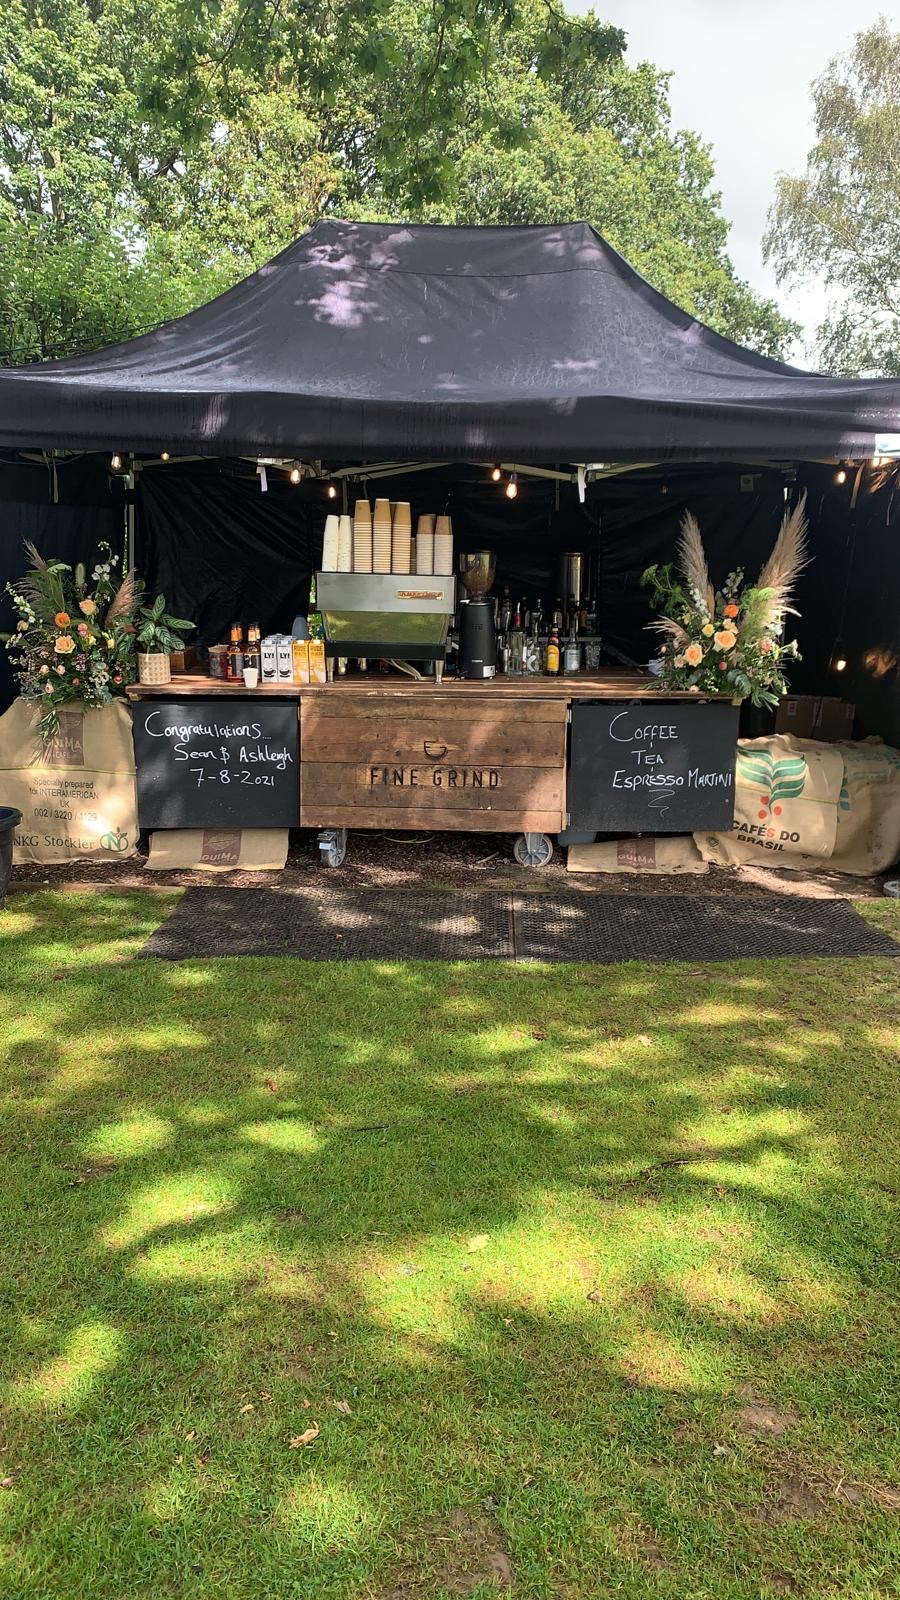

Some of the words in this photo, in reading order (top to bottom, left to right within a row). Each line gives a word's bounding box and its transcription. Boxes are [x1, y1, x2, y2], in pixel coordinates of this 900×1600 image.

[173, 743, 217, 761] Sean
[239, 745, 293, 770] Ashleigh
[33, 776, 63, 788] Specially
[64, 780, 94, 789] prepared
[190, 767, 275, 788] 7-8-2021
[370, 767, 419, 786] FINE
[432, 769, 500, 788] GRIND
[39, 788, 99, 800] INTERAMERICAN
[60, 800, 70, 808] UK
[34, 808, 49, 818] 002
[54, 810, 73, 821] 3220
[732, 819, 775, 839] CAFÉS
[779, 831, 800, 843] DO
[13, 835, 39, 847] NKG
[44, 835, 95, 850] Stockler
[737, 834, 785, 852] BRASIL
